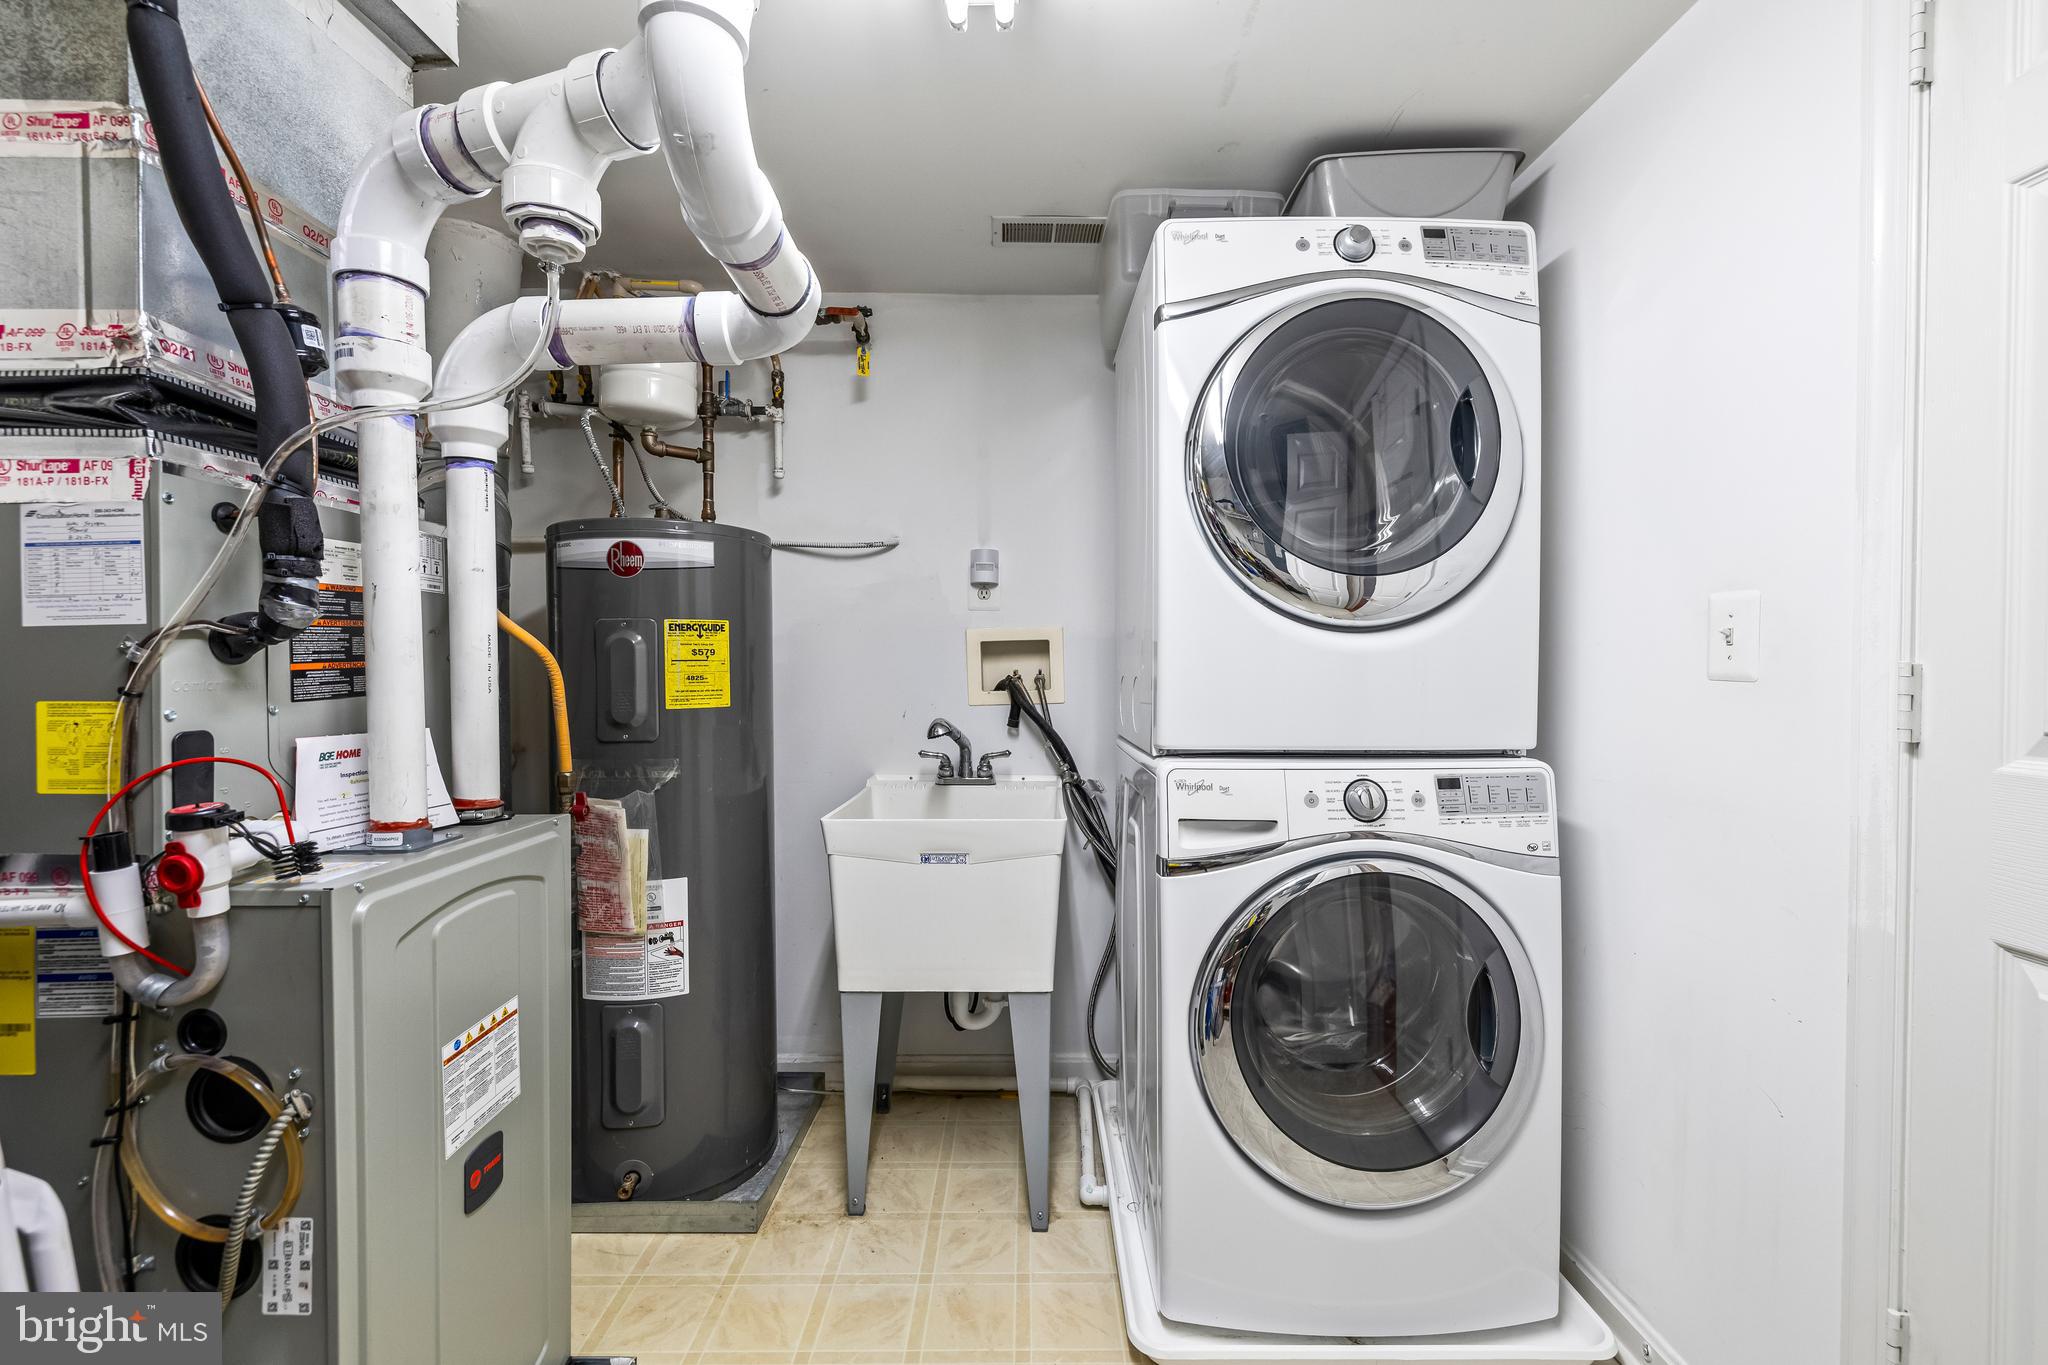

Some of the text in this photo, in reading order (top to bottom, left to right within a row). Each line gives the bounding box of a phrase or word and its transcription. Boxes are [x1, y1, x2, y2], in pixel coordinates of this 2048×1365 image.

[93, 115, 107, 126] AF
[110, 116, 130, 127] 099
[302, 225, 329, 249] Q2/21
[1171, 231, 1208, 243] Whirlpool
[6, 328, 24, 338] AF
[158, 338, 196, 362] Q2/21
[230, 376, 253, 391] 181A
[16, 459, 113, 474] Shurtape AF 09
[17, 477, 55, 487] 181A-P
[65, 476, 109, 487] 181B-FX
[610, 541, 643, 573] Rheem
[332, 584, 357, 592] WARNING
[323, 619, 365, 627] AVERTISSEMEN
[668, 623, 726, 633] ENERGYGUIDE
[691, 648, 716, 657] $579
[487, 663, 492, 672] IN
[318, 748, 362, 761] BGE HOME
[340, 769, 369, 778] Inspection
[1175, 780, 1214, 794] Whirlpool
